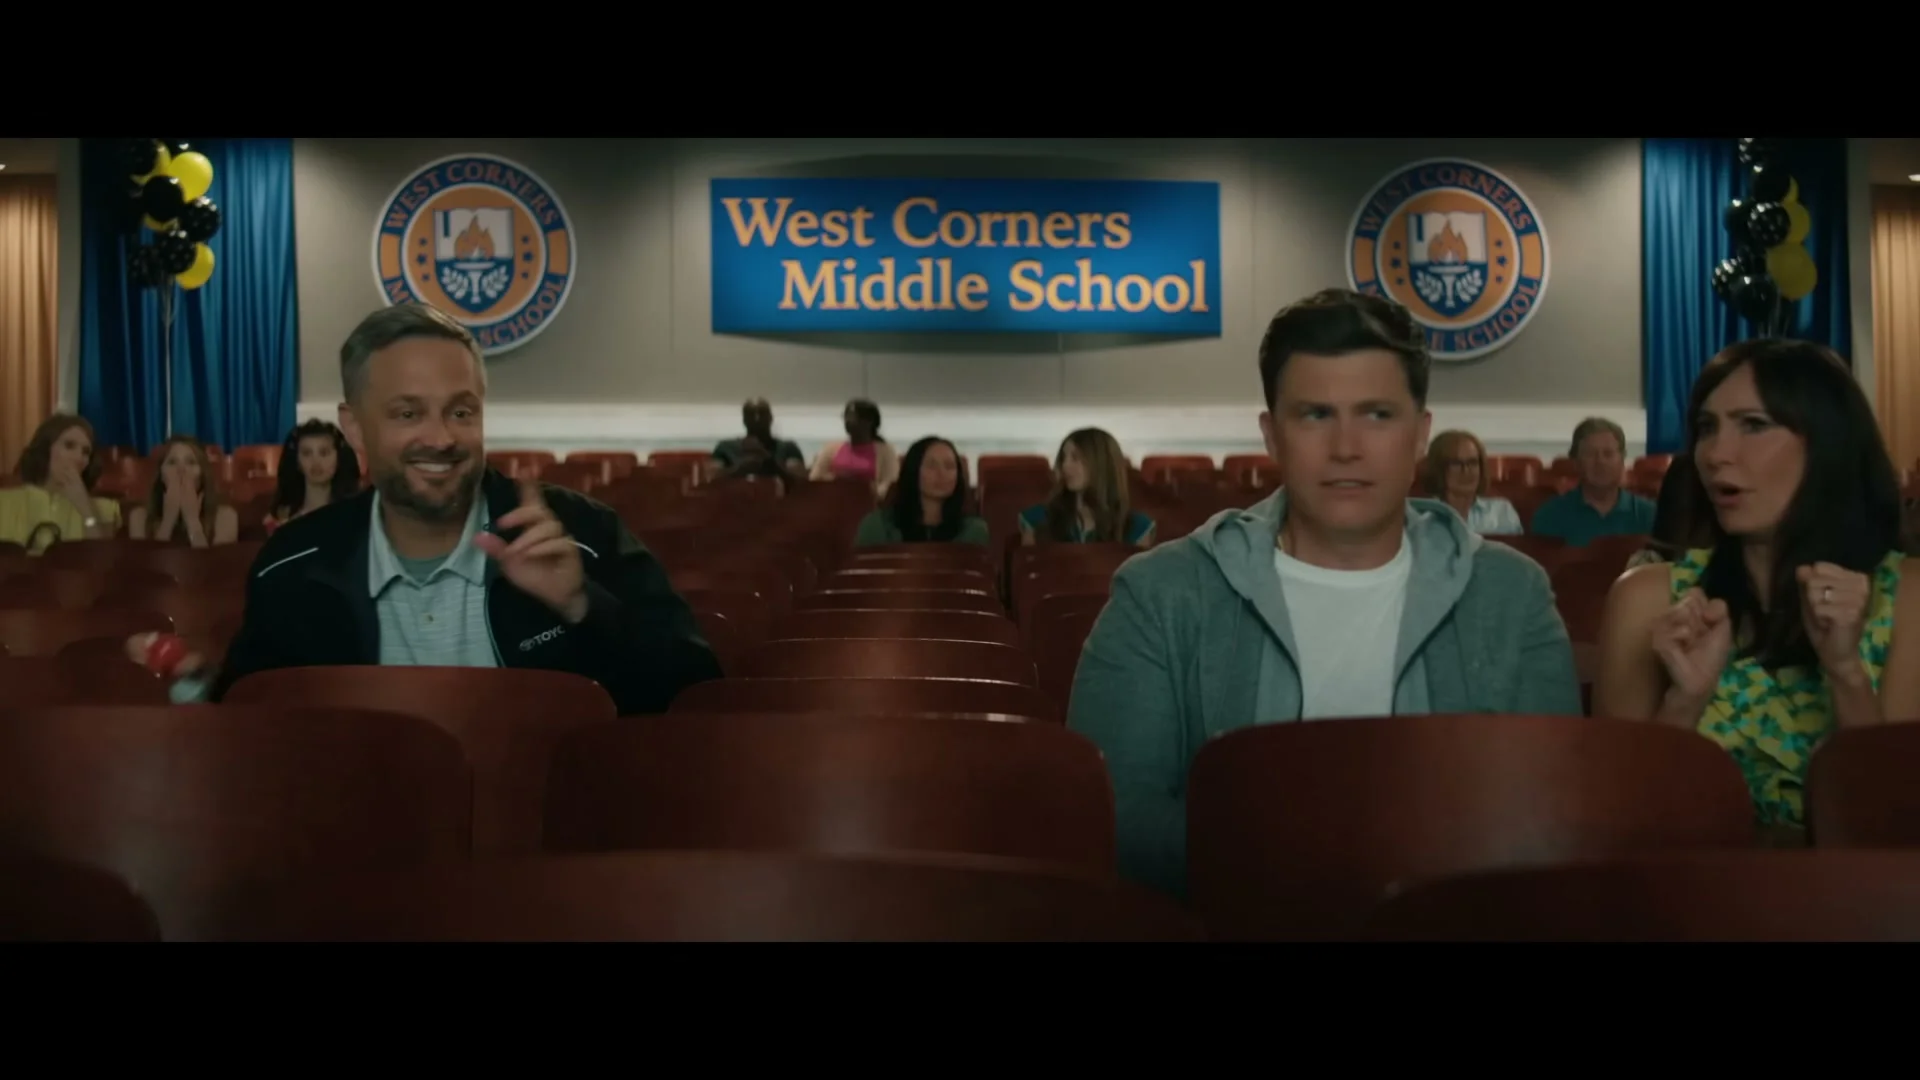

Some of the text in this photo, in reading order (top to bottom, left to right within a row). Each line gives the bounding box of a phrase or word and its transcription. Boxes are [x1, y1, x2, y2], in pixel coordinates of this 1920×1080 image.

[387, 161, 559, 229] WEST CORNERS
[721, 196, 1133, 249] West Corners
[1360, 166, 1532, 231] WEST CORNERS
[479, 280, 566, 347] SCHOOL
[778, 259, 1209, 312] Middle School
[1454, 282, 1539, 350] SCHOOL
[534, 624, 566, 645] TOYO
